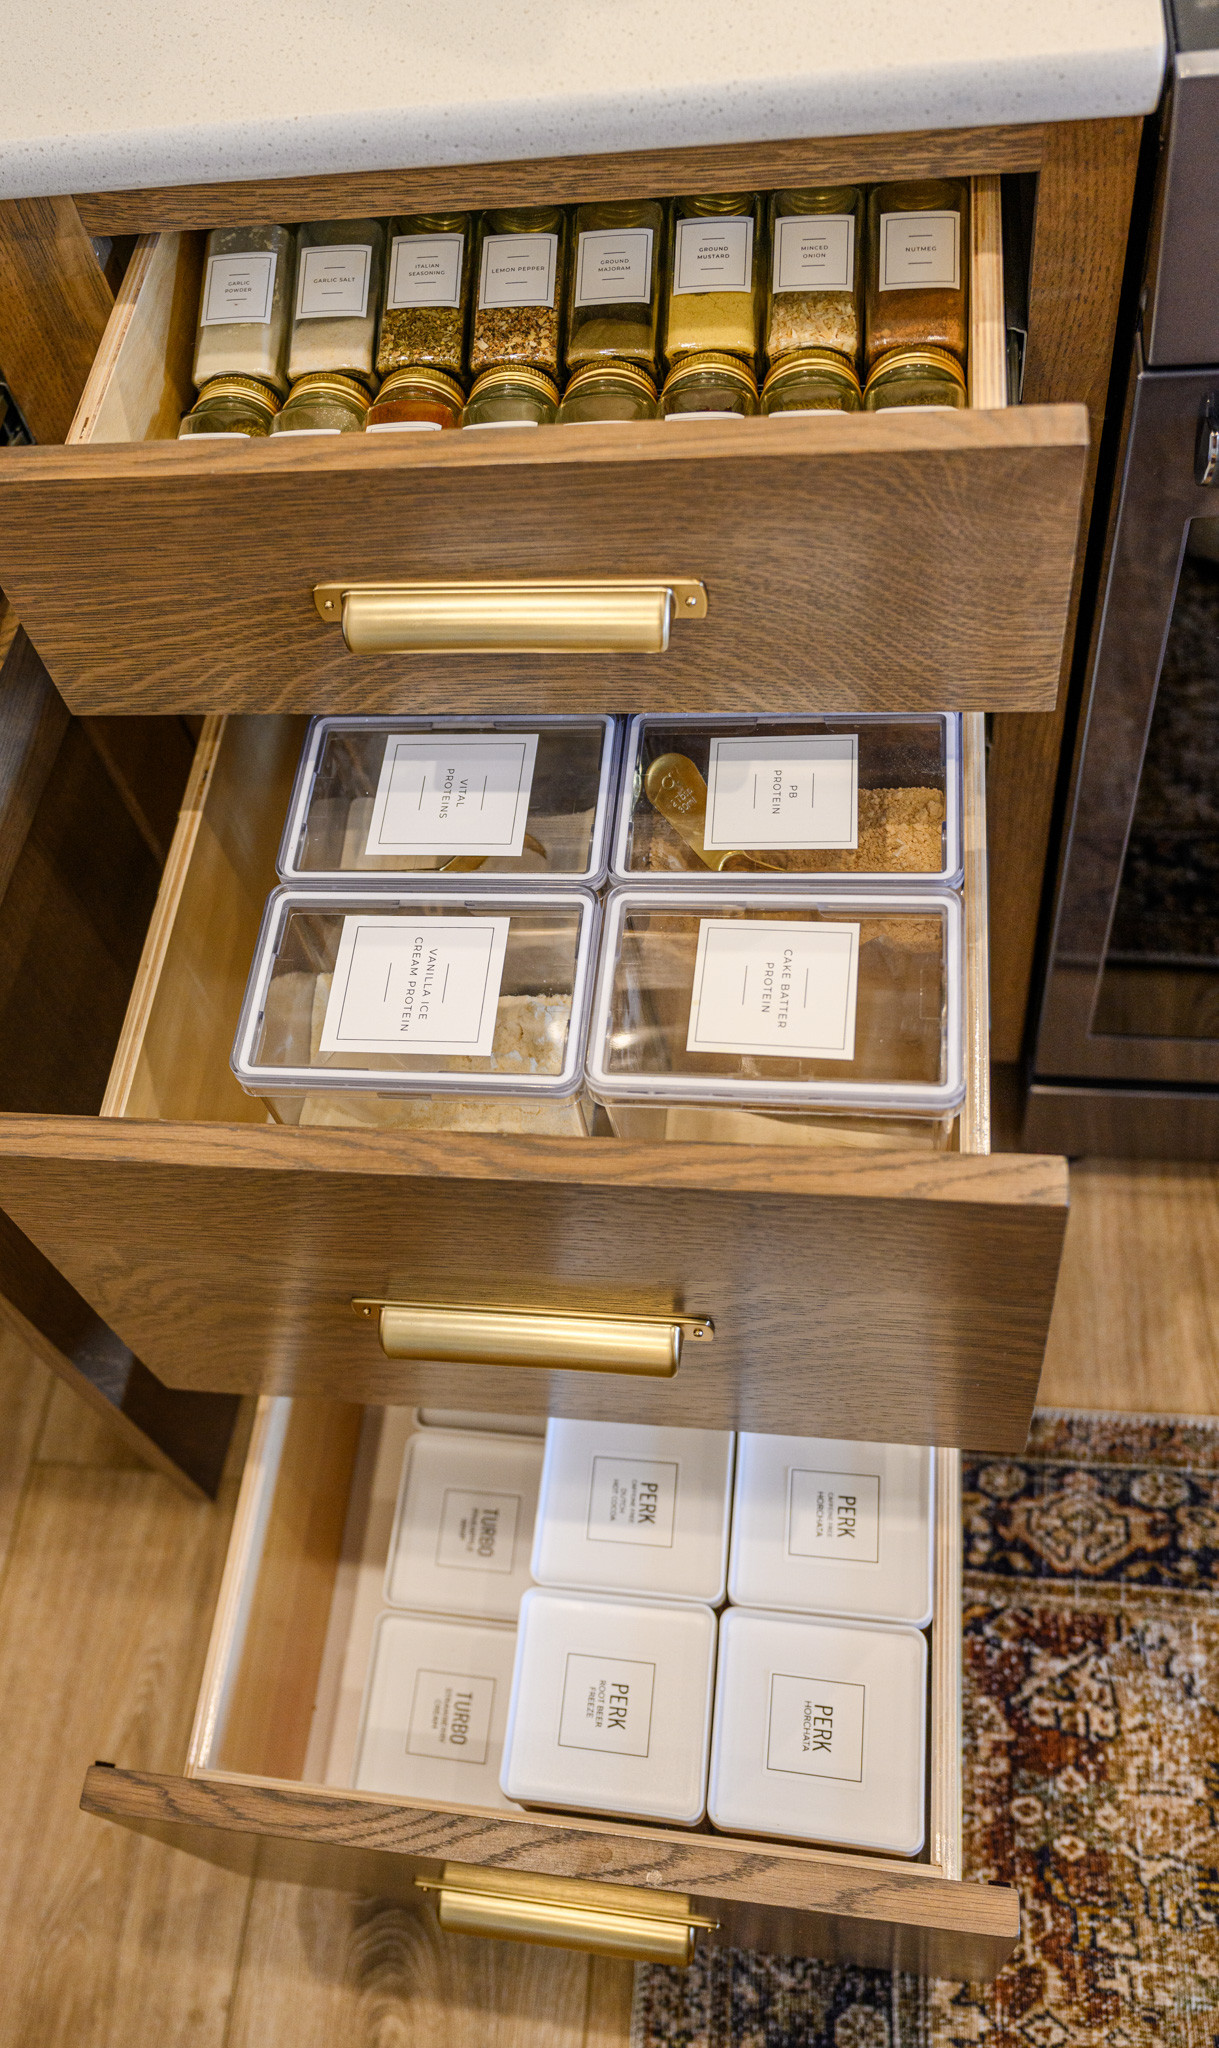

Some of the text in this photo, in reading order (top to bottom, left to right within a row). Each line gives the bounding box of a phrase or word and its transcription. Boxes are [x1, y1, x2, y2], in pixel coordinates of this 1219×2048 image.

[438, 768, 456, 819] PROTEINS
[455, 778, 469, 808] VITAL
[771, 769, 783, 815] PROTEIN
[788, 784, 798, 799] PB
[400, 936, 424, 1032] CREAM PROTEIN
[417, 948, 438, 1020] VANILLA ICE
[761, 961, 775, 1014] PROTEIN
[777, 948, 794, 1029] CAKE BATTER
[637, 1482, 659, 1525] PERK
[815, 1491, 824, 1538] HORCHATA
[836, 1495, 857, 1538] PERK
[477, 1508, 499, 1558] TURBO
[449, 1692, 473, 1745] TURBO
[586, 1687, 596, 1718] FREEZE
[595, 1680, 606, 1728] ROOT BEER
[607, 1683, 630, 1730] PERK
[802, 1700, 812, 1752] HORCHATA
[812, 1704, 834, 1753] PERK
